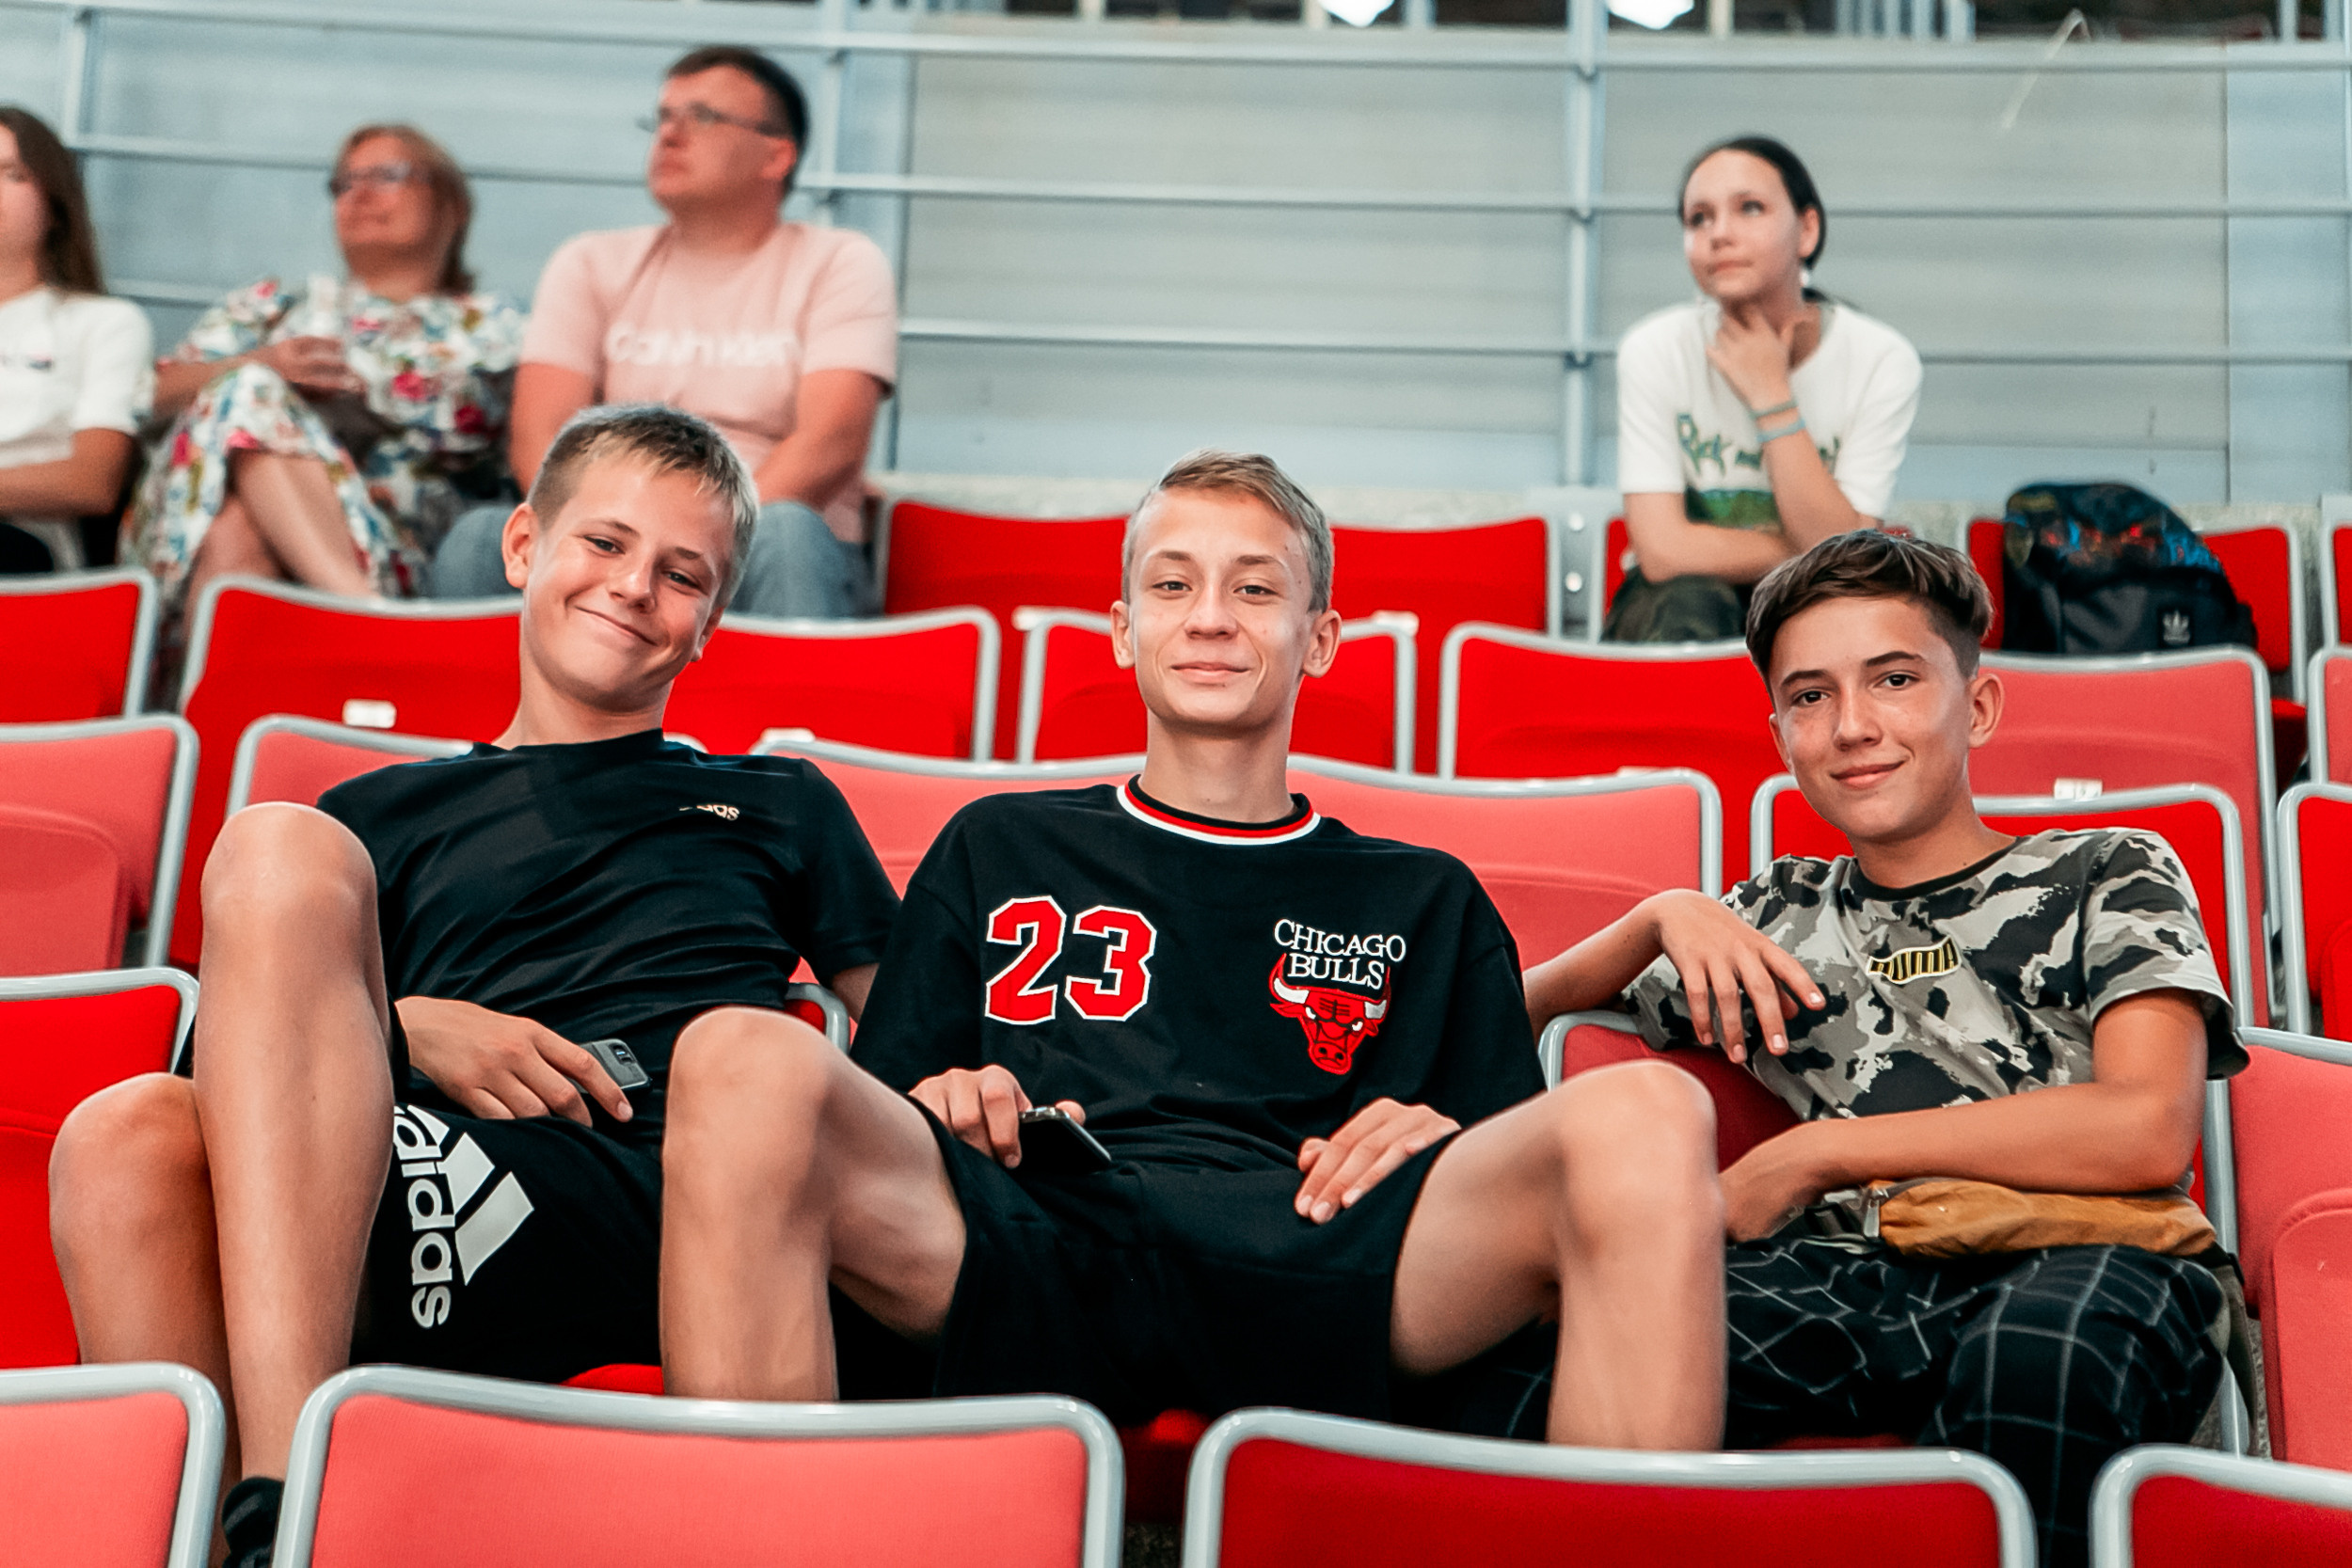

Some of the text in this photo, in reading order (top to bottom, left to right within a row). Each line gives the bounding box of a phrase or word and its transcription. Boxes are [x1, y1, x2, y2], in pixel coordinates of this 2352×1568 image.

[985, 895, 1157, 1025] 23
[1274, 918, 1406, 962] CHICAGO
[1869, 938, 1959, 982] PUMA
[1287, 953, 1385, 990] BULLS
[393, 1105, 455, 1328] didas
